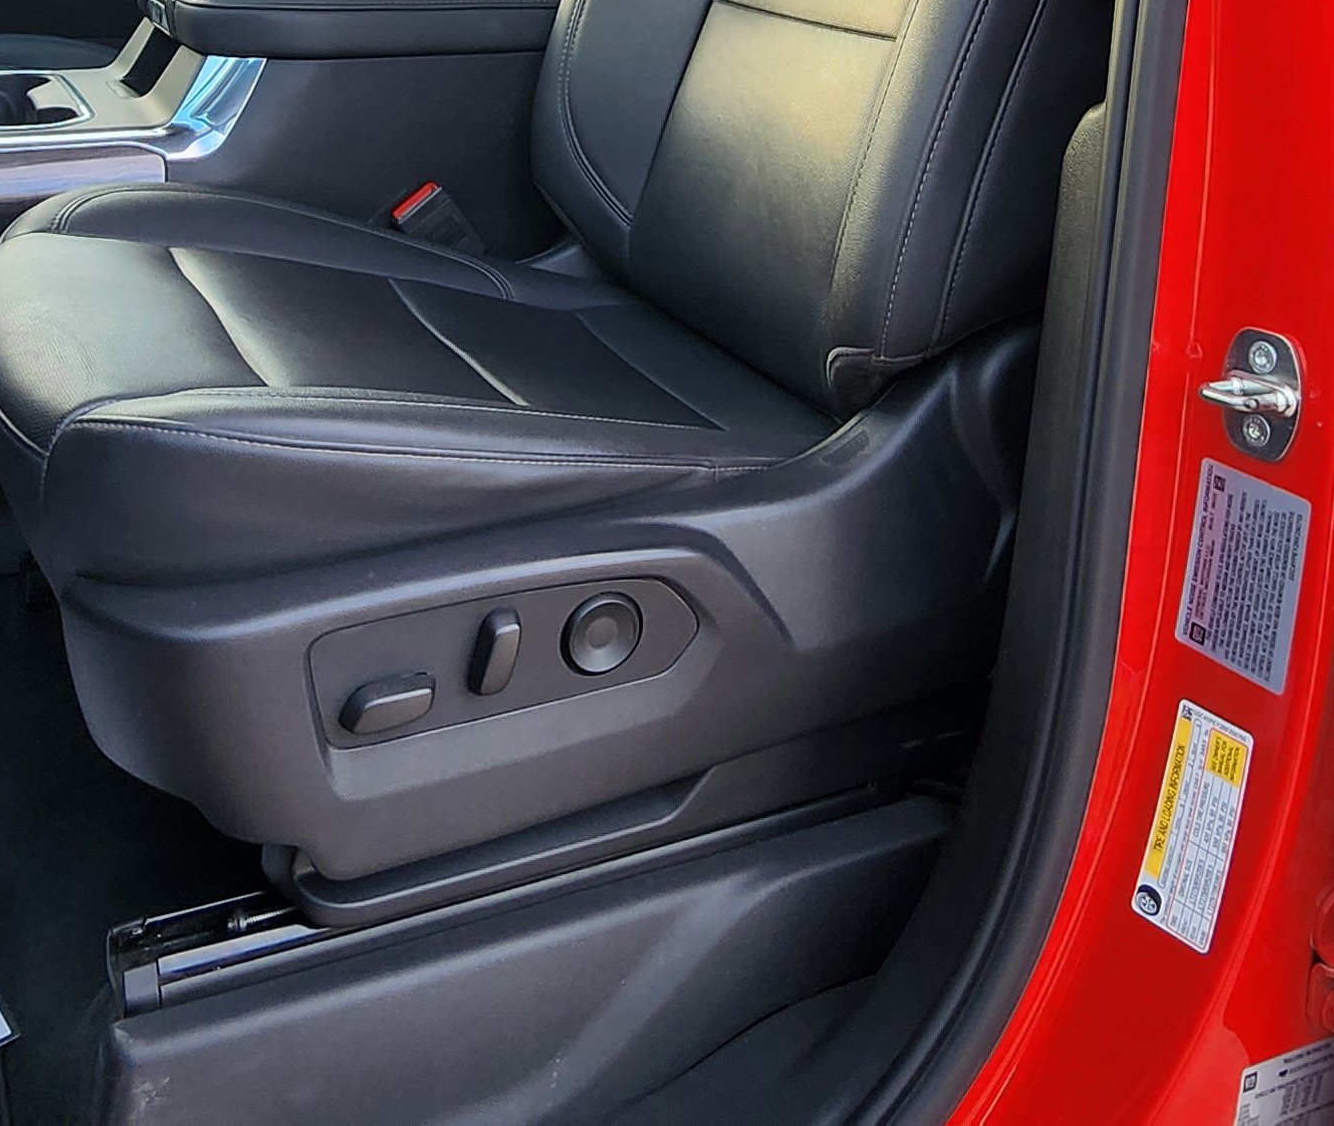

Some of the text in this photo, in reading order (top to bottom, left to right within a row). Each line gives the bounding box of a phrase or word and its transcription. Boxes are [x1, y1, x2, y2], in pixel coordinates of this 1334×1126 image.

[1169, 745, 1185, 790] INFORMATION
[1162, 789, 1176, 825] LOADING
[1158, 820, 1168, 838] AND
[1154, 836, 1165, 853] TIRE
